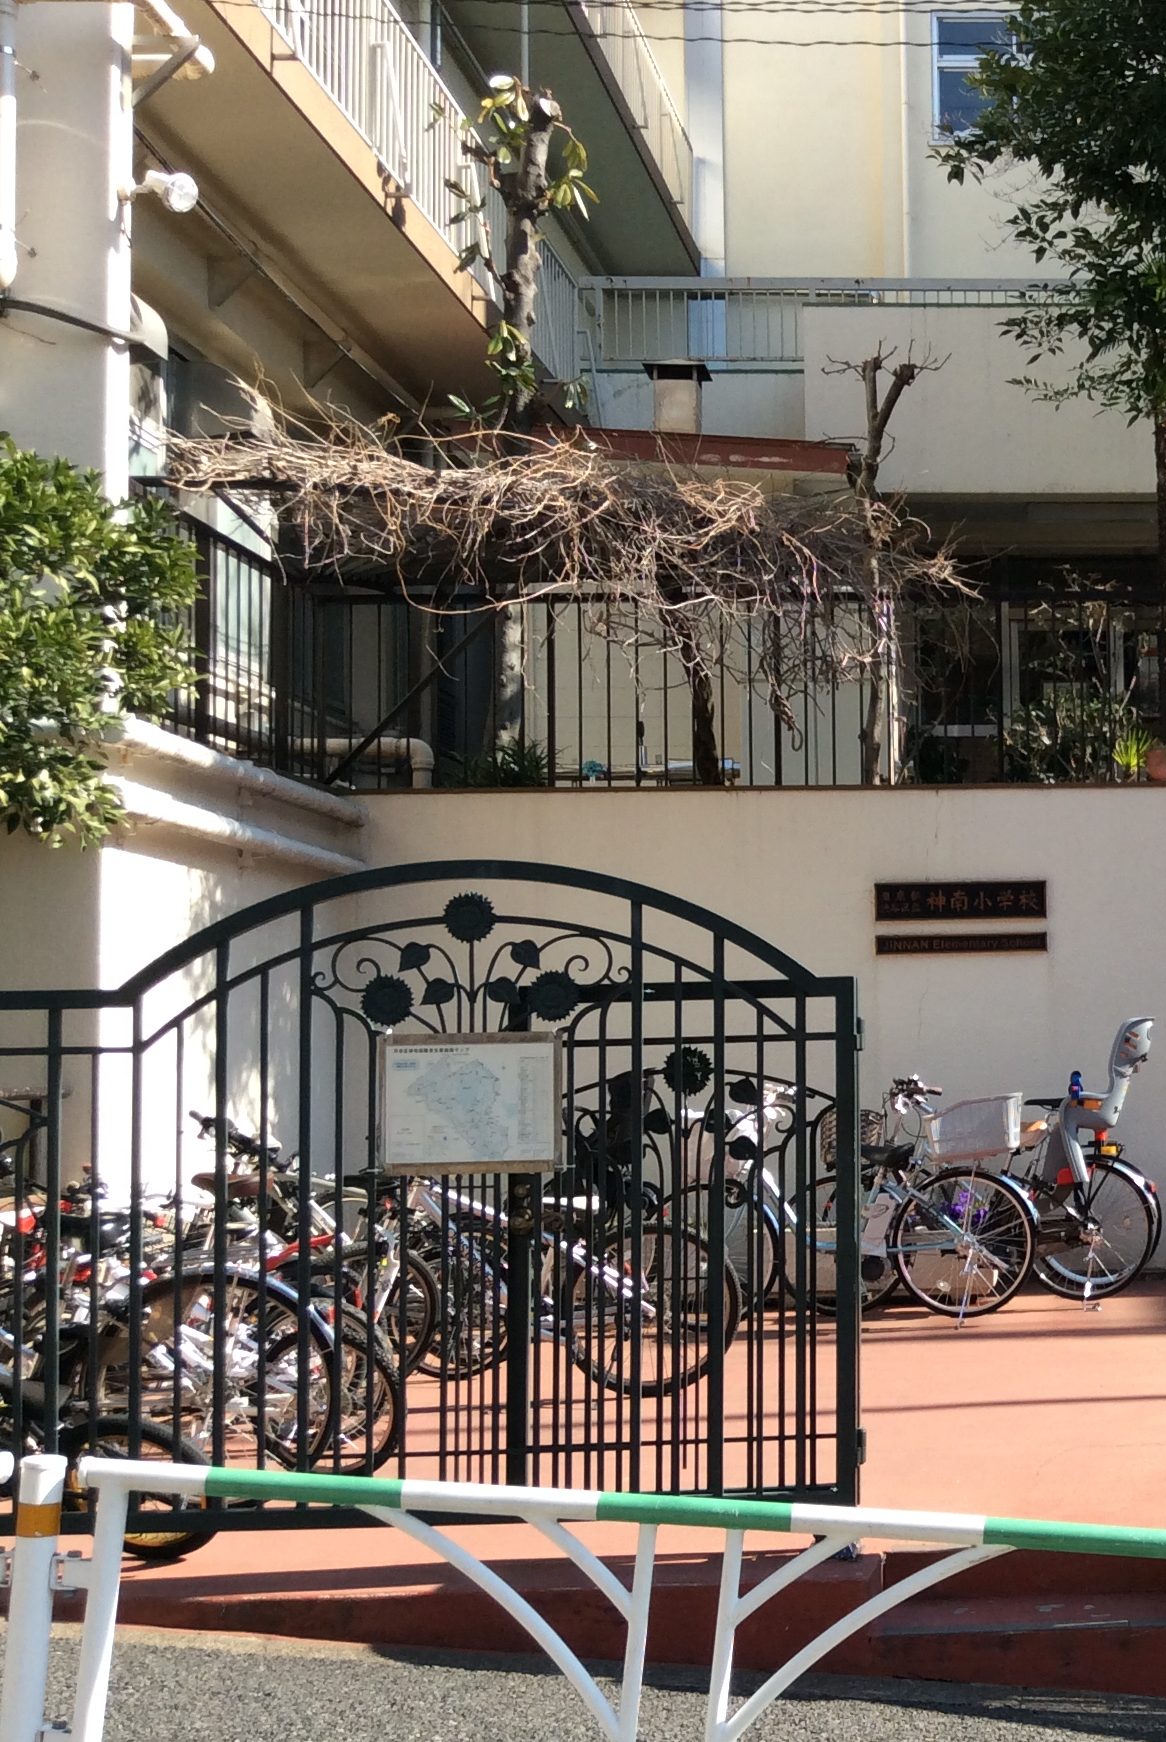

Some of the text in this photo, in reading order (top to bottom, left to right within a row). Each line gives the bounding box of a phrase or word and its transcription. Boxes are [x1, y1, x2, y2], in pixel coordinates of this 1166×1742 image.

[927, 889, 1041, 913] 神南小学校
[932, 939, 999, 950] Elementary
